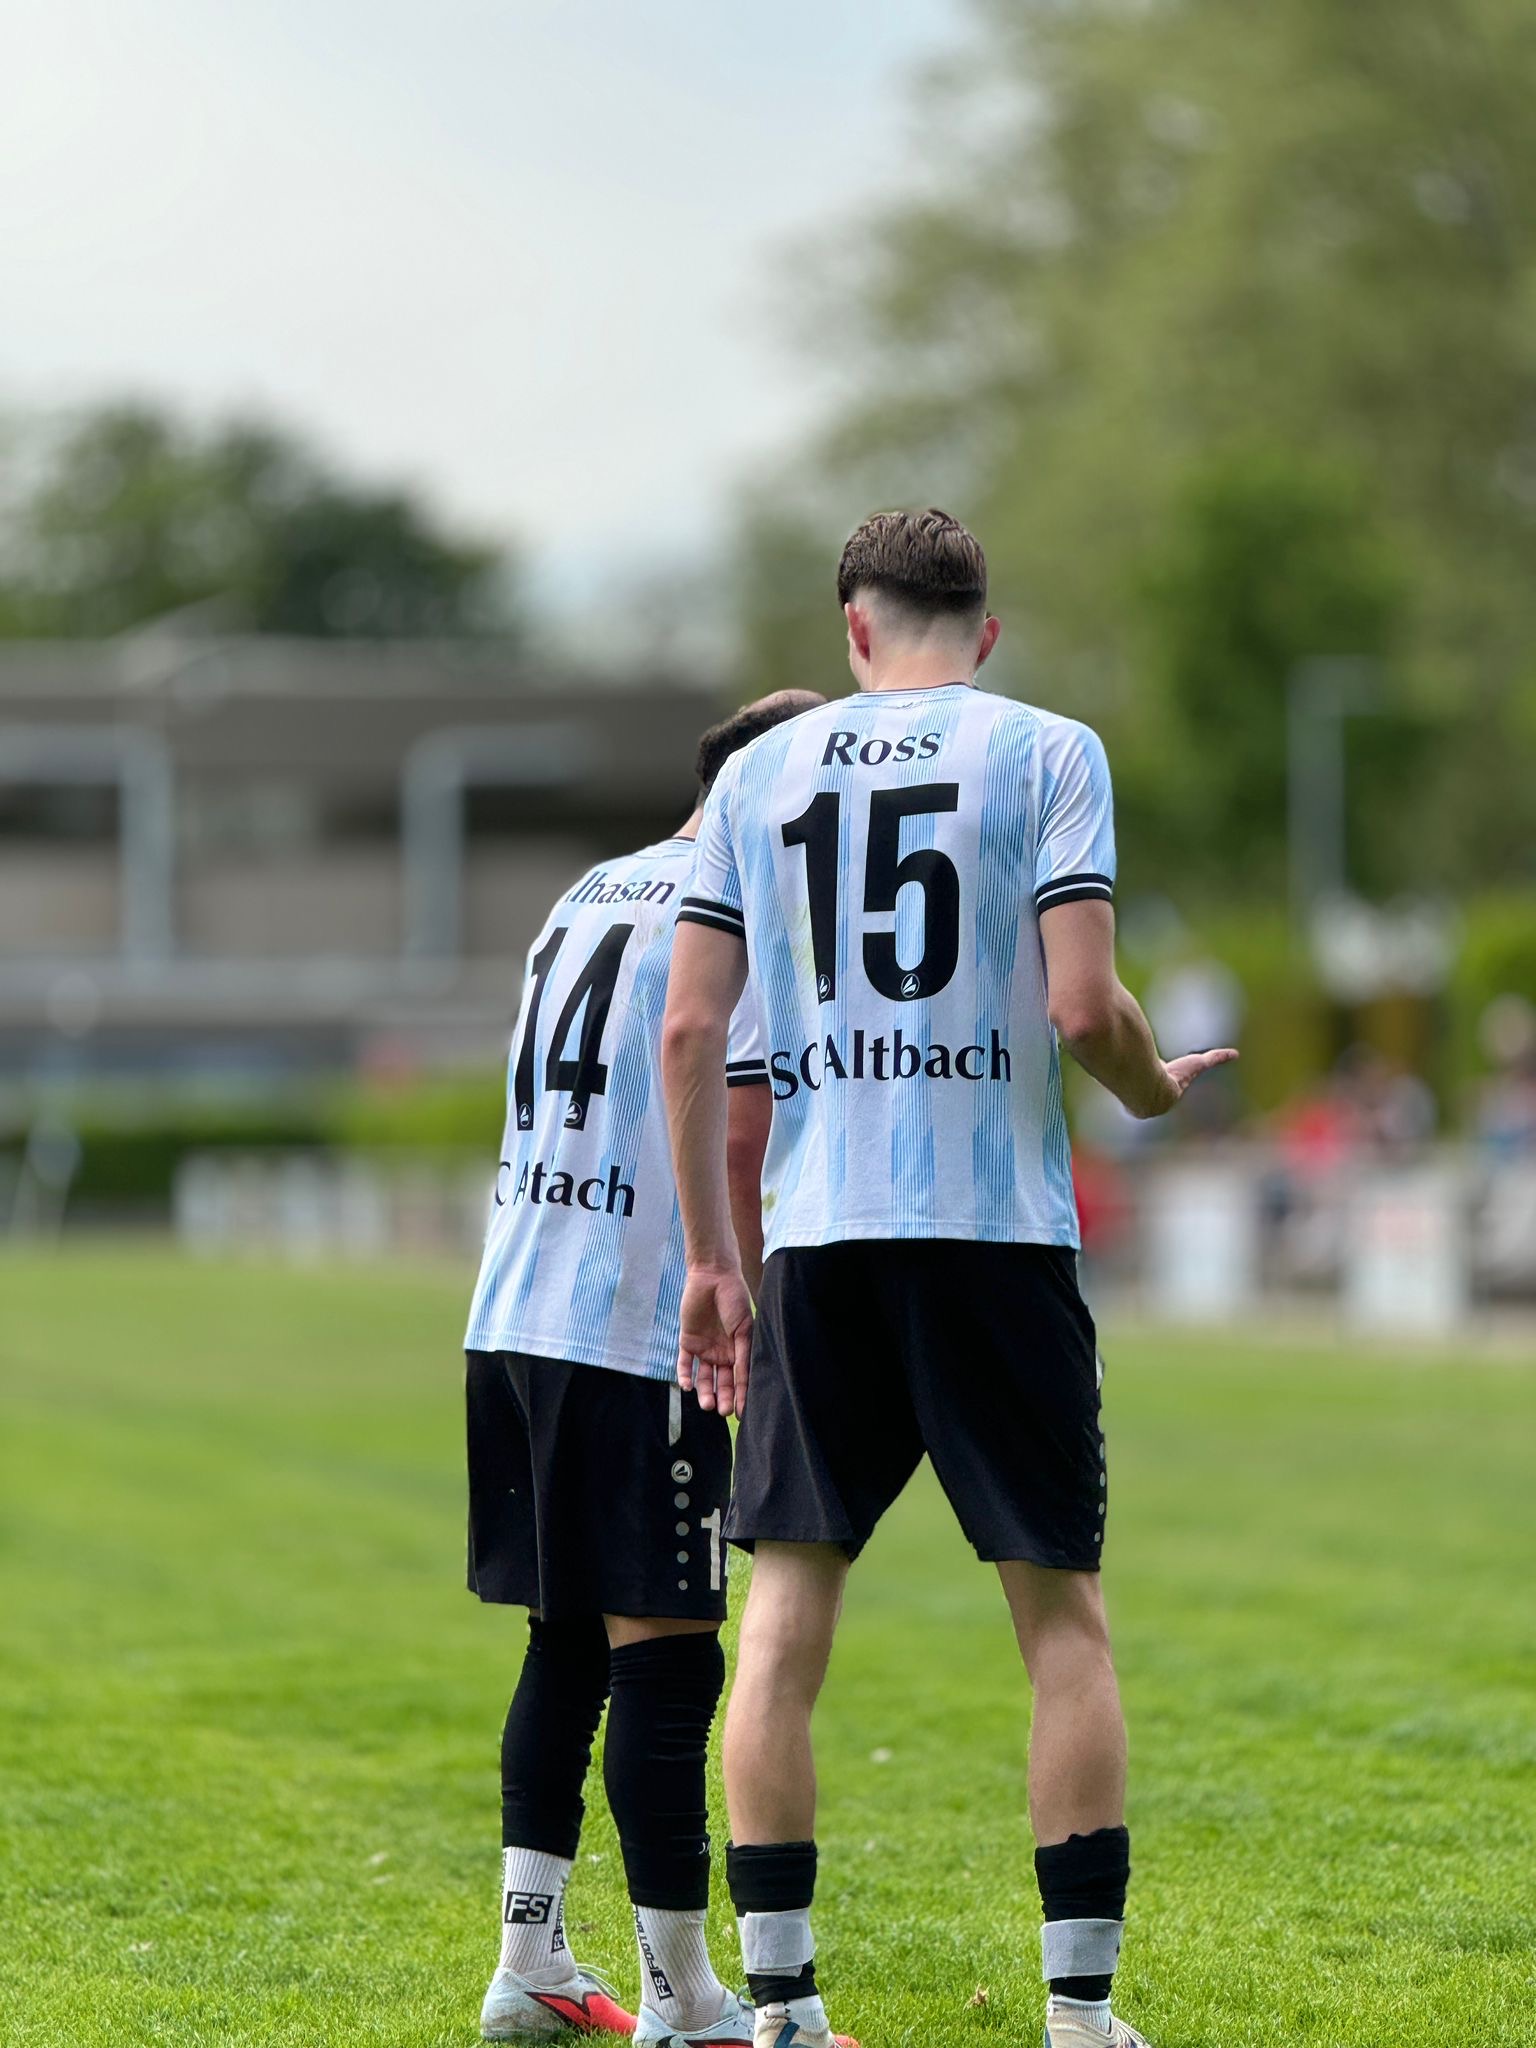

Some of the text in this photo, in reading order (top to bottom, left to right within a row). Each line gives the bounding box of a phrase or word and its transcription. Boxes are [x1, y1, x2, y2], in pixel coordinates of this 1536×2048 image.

[821, 731, 941, 766] Ross
[564, 871, 676, 904] lhasan
[781, 783, 960, 1005] 15
[514, 923, 636, 1131] 14
[701, 1508, 727, 1591] 1
[506, 1893, 550, 1923] FS
[653, 1973, 672, 1998] FS
